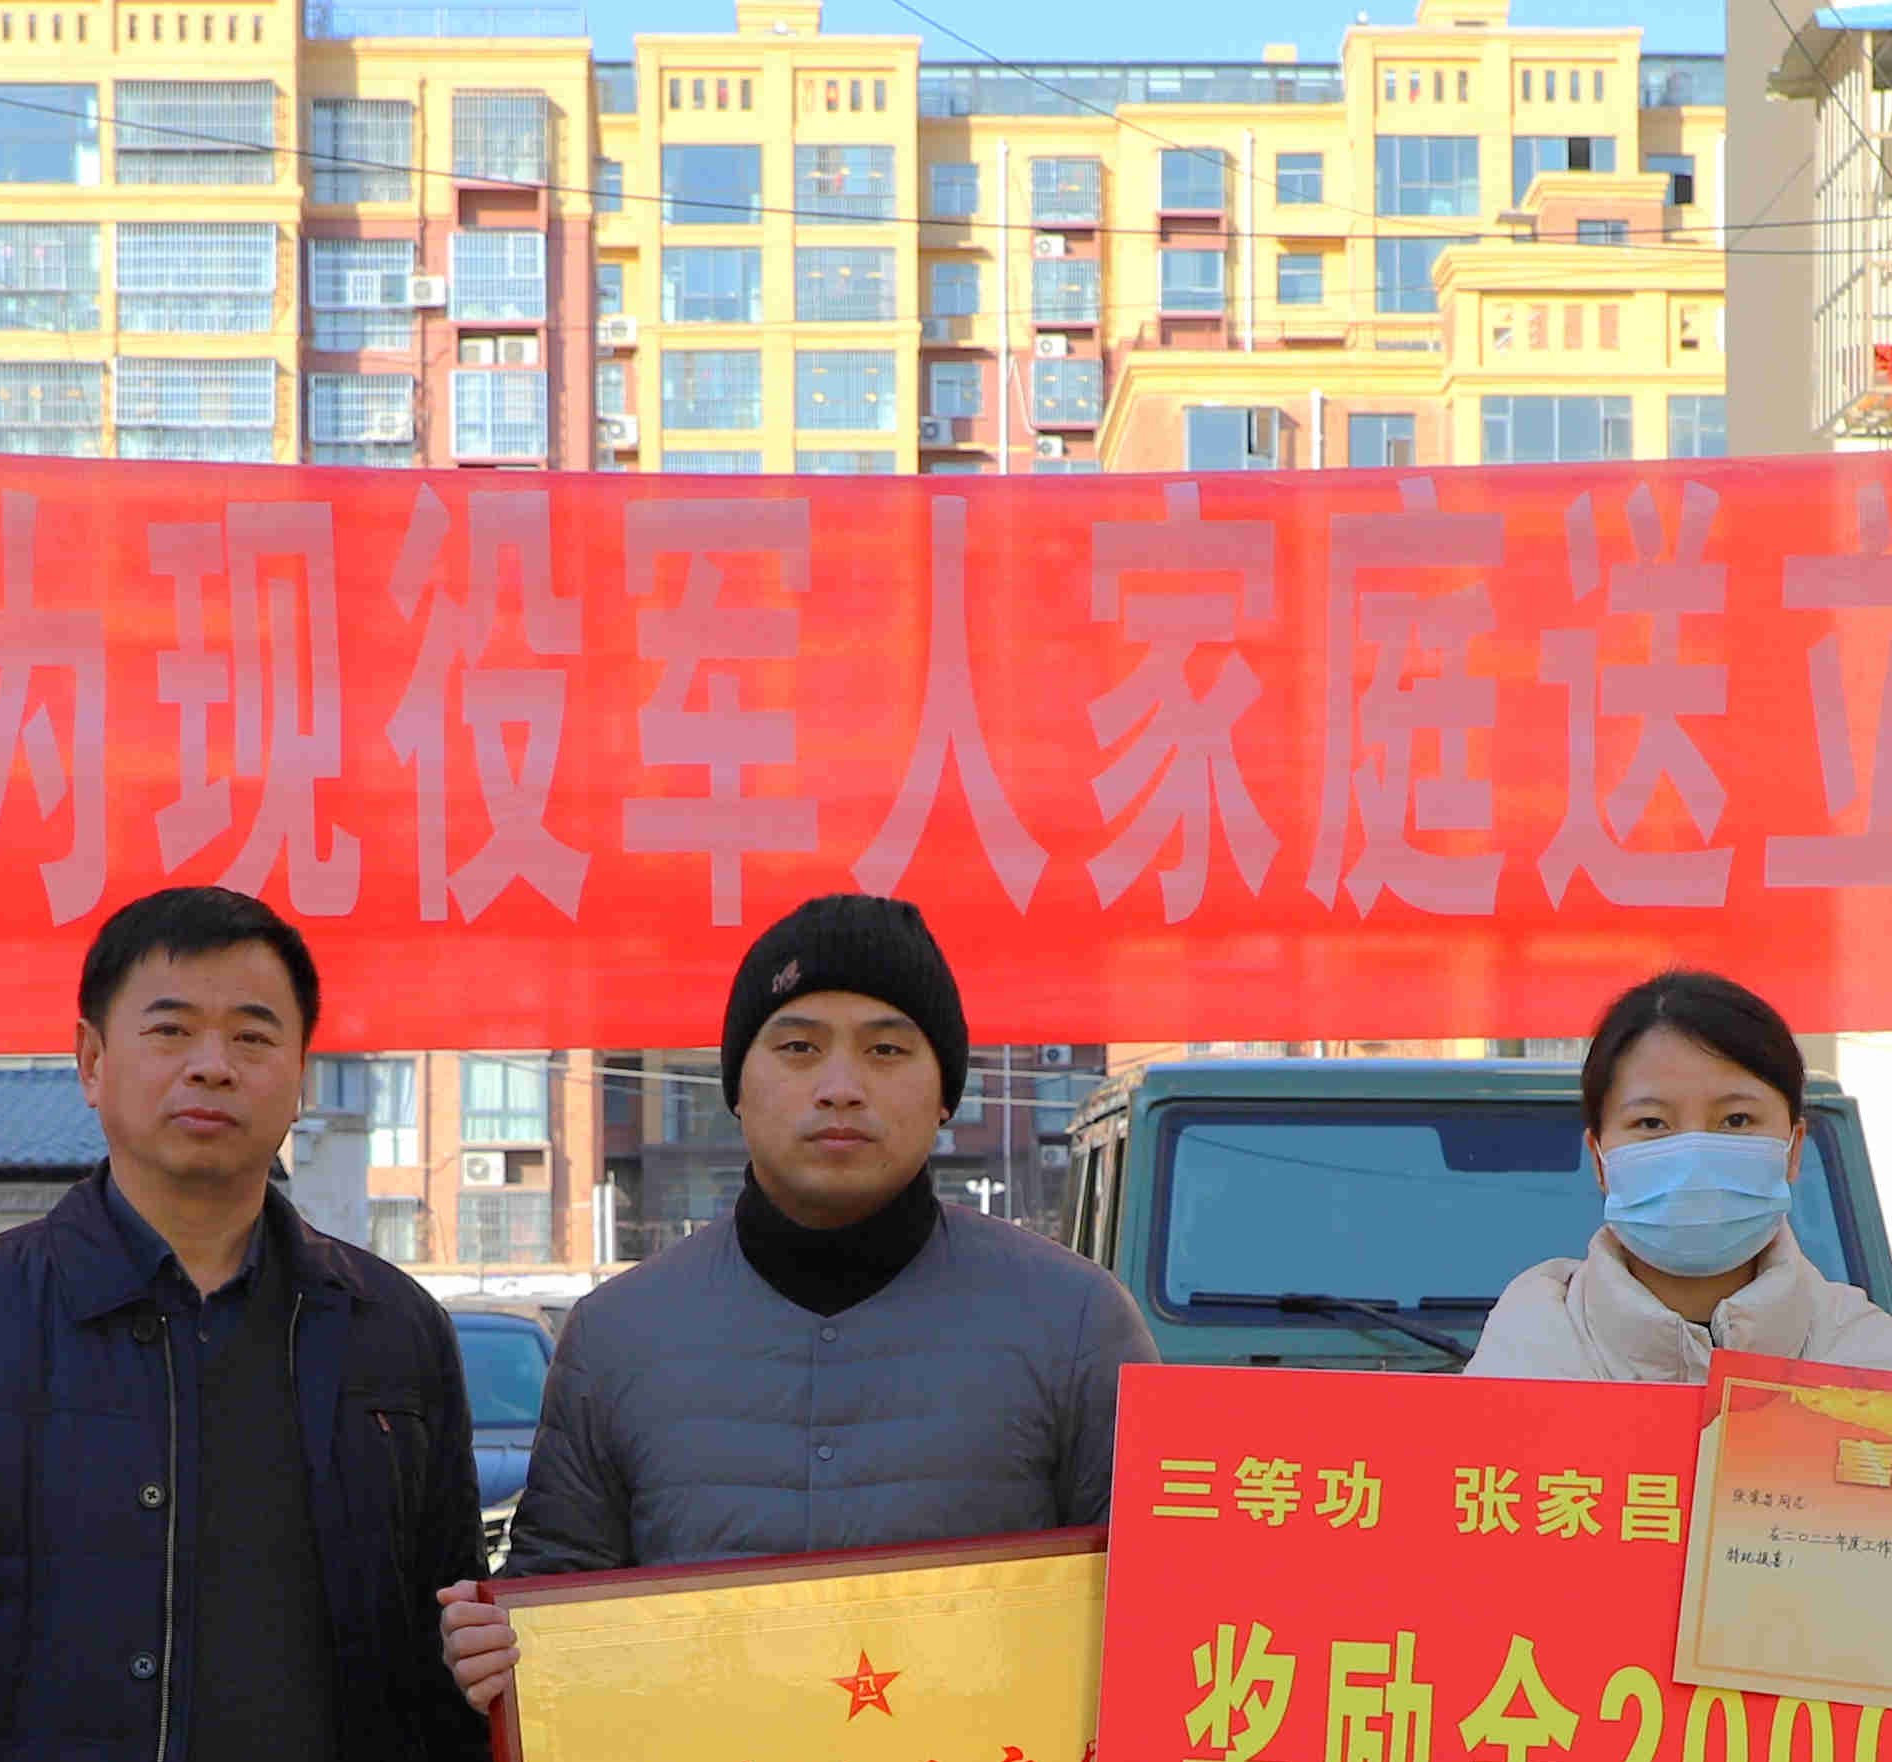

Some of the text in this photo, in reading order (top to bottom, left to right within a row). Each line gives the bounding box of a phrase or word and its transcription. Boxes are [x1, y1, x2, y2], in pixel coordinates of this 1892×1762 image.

[1152, 1456, 1682, 1546] 三等功 张家昌
